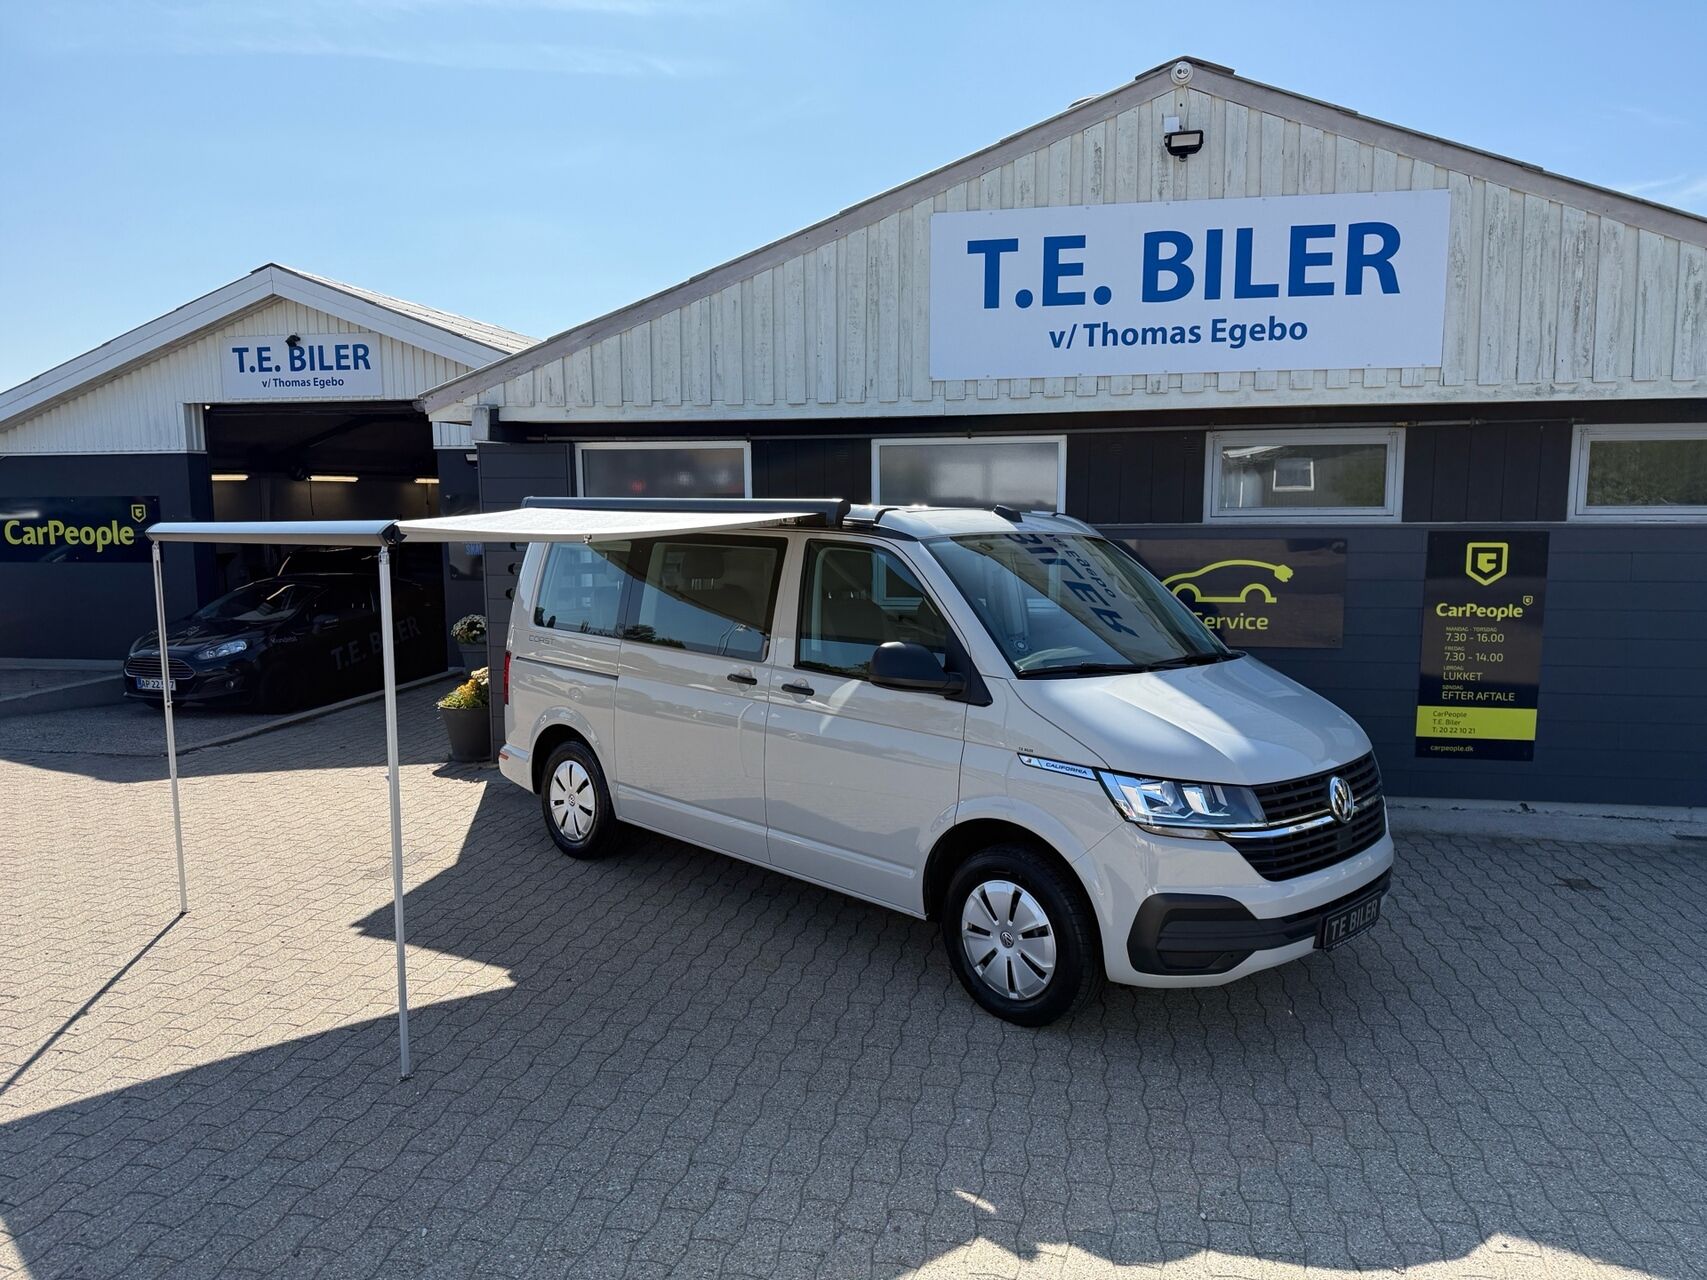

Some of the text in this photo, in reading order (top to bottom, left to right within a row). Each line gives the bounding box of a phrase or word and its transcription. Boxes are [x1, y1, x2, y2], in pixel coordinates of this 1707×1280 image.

[967, 221, 1401, 310] T.E. BILER
[1049, 315, 1309, 350] v/ Thomas Egebo
[231, 343, 372, 373] T.E. BILER
[261, 376, 345, 389] v/ Thomas Egebo
[4, 519, 135, 553] CarPeople
[1436, 603, 1523, 621] CarPeople
[1193, 612, 1269, 630] ervice
[369, 616, 422, 655] BER
[1445, 632, 1467, 642] 7.30
[1477, 633, 1505, 643] 16.00
[1444, 652, 1466, 662] 7.30
[1475, 652, 1504, 662] 14.00
[1443, 671, 1483, 681] LUKKET
[1442, 690, 1515, 702] EFTER AFTALE
[1432, 710, 1468, 719] CarPeople
[1430, 744, 1474, 752] carpeople.dk
[1045, 762, 1088, 775] CALIFORNIA
[1331, 915, 1347, 940] TE
[1349, 899, 1379, 932] BILER
